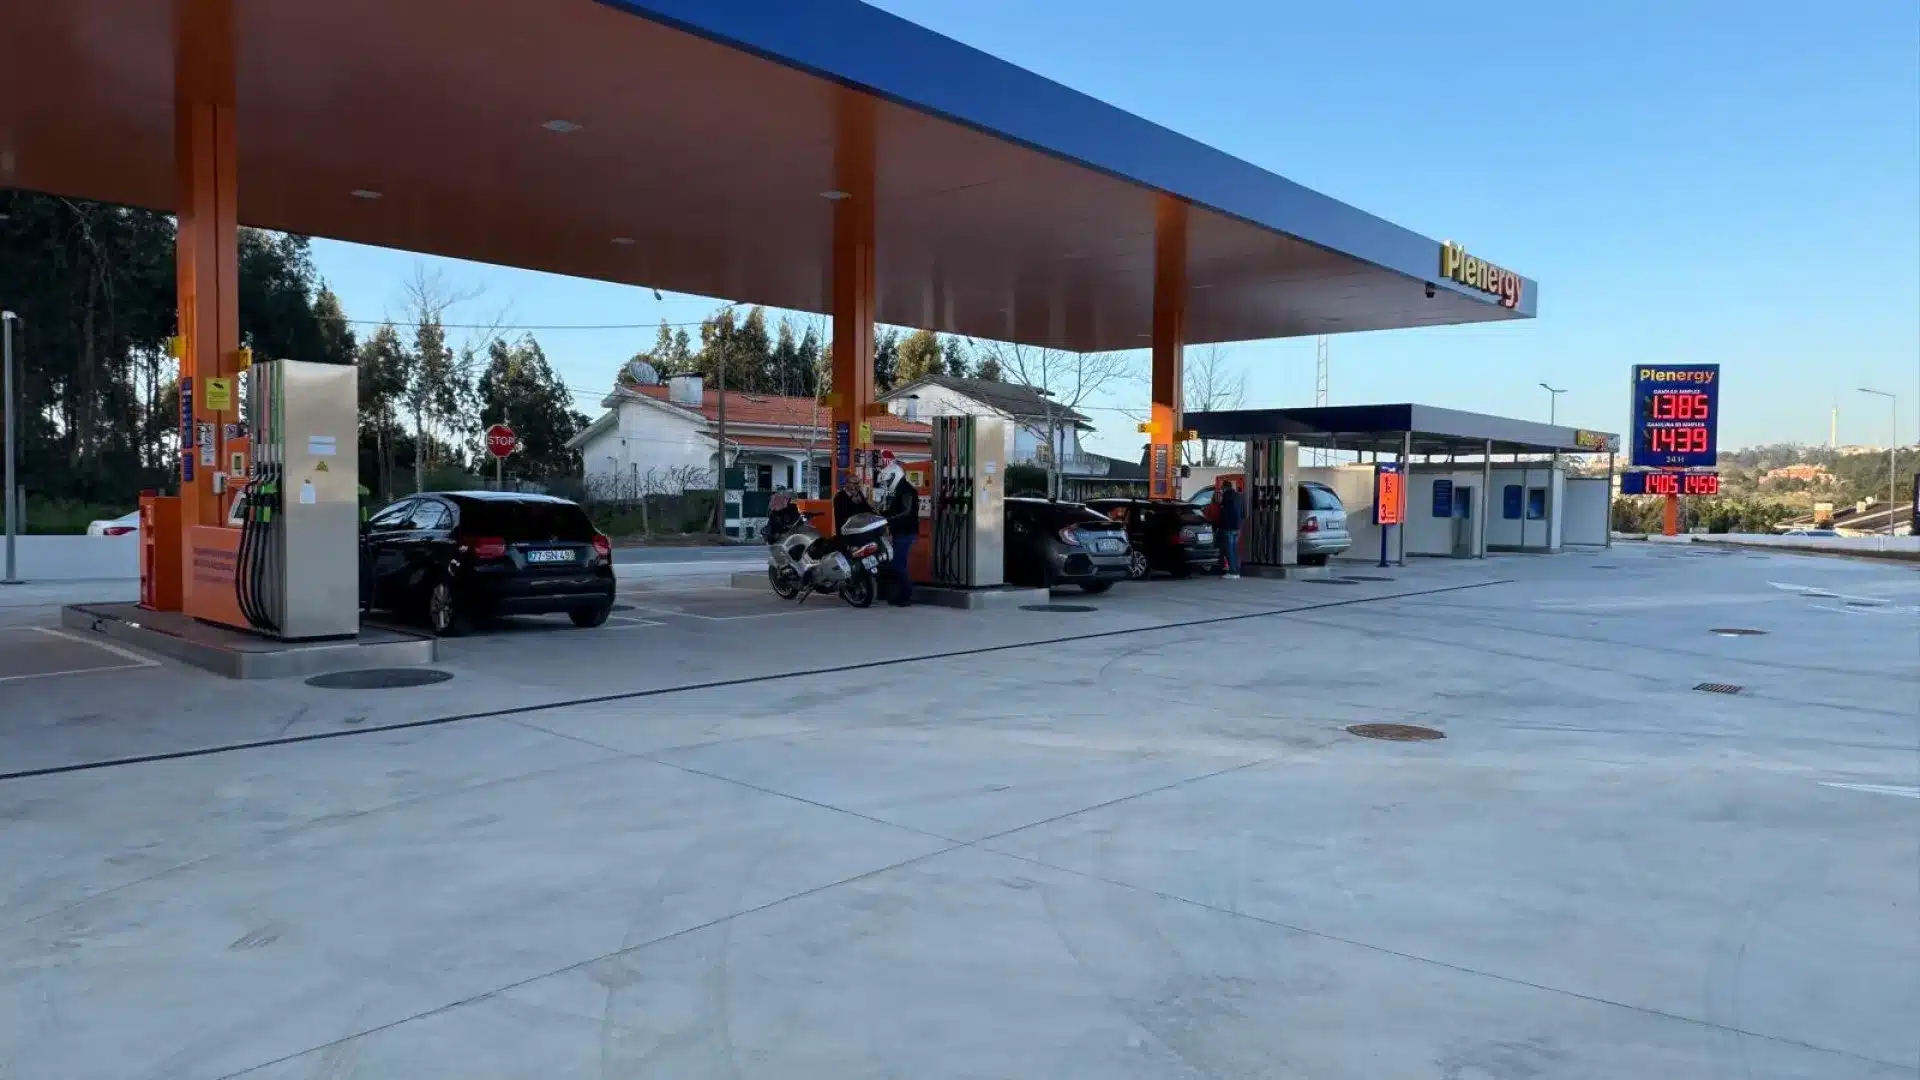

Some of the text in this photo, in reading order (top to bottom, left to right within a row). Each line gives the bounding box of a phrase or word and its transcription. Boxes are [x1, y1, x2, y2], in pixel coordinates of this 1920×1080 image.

[1443, 240, 1524, 308] Plenergy
[1640, 369, 1715, 384] Plenergy
[1653, 395, 1708, 419] 1.385
[488, 436, 515, 446] STOP
[1652, 428, 1708, 452] 1.439
